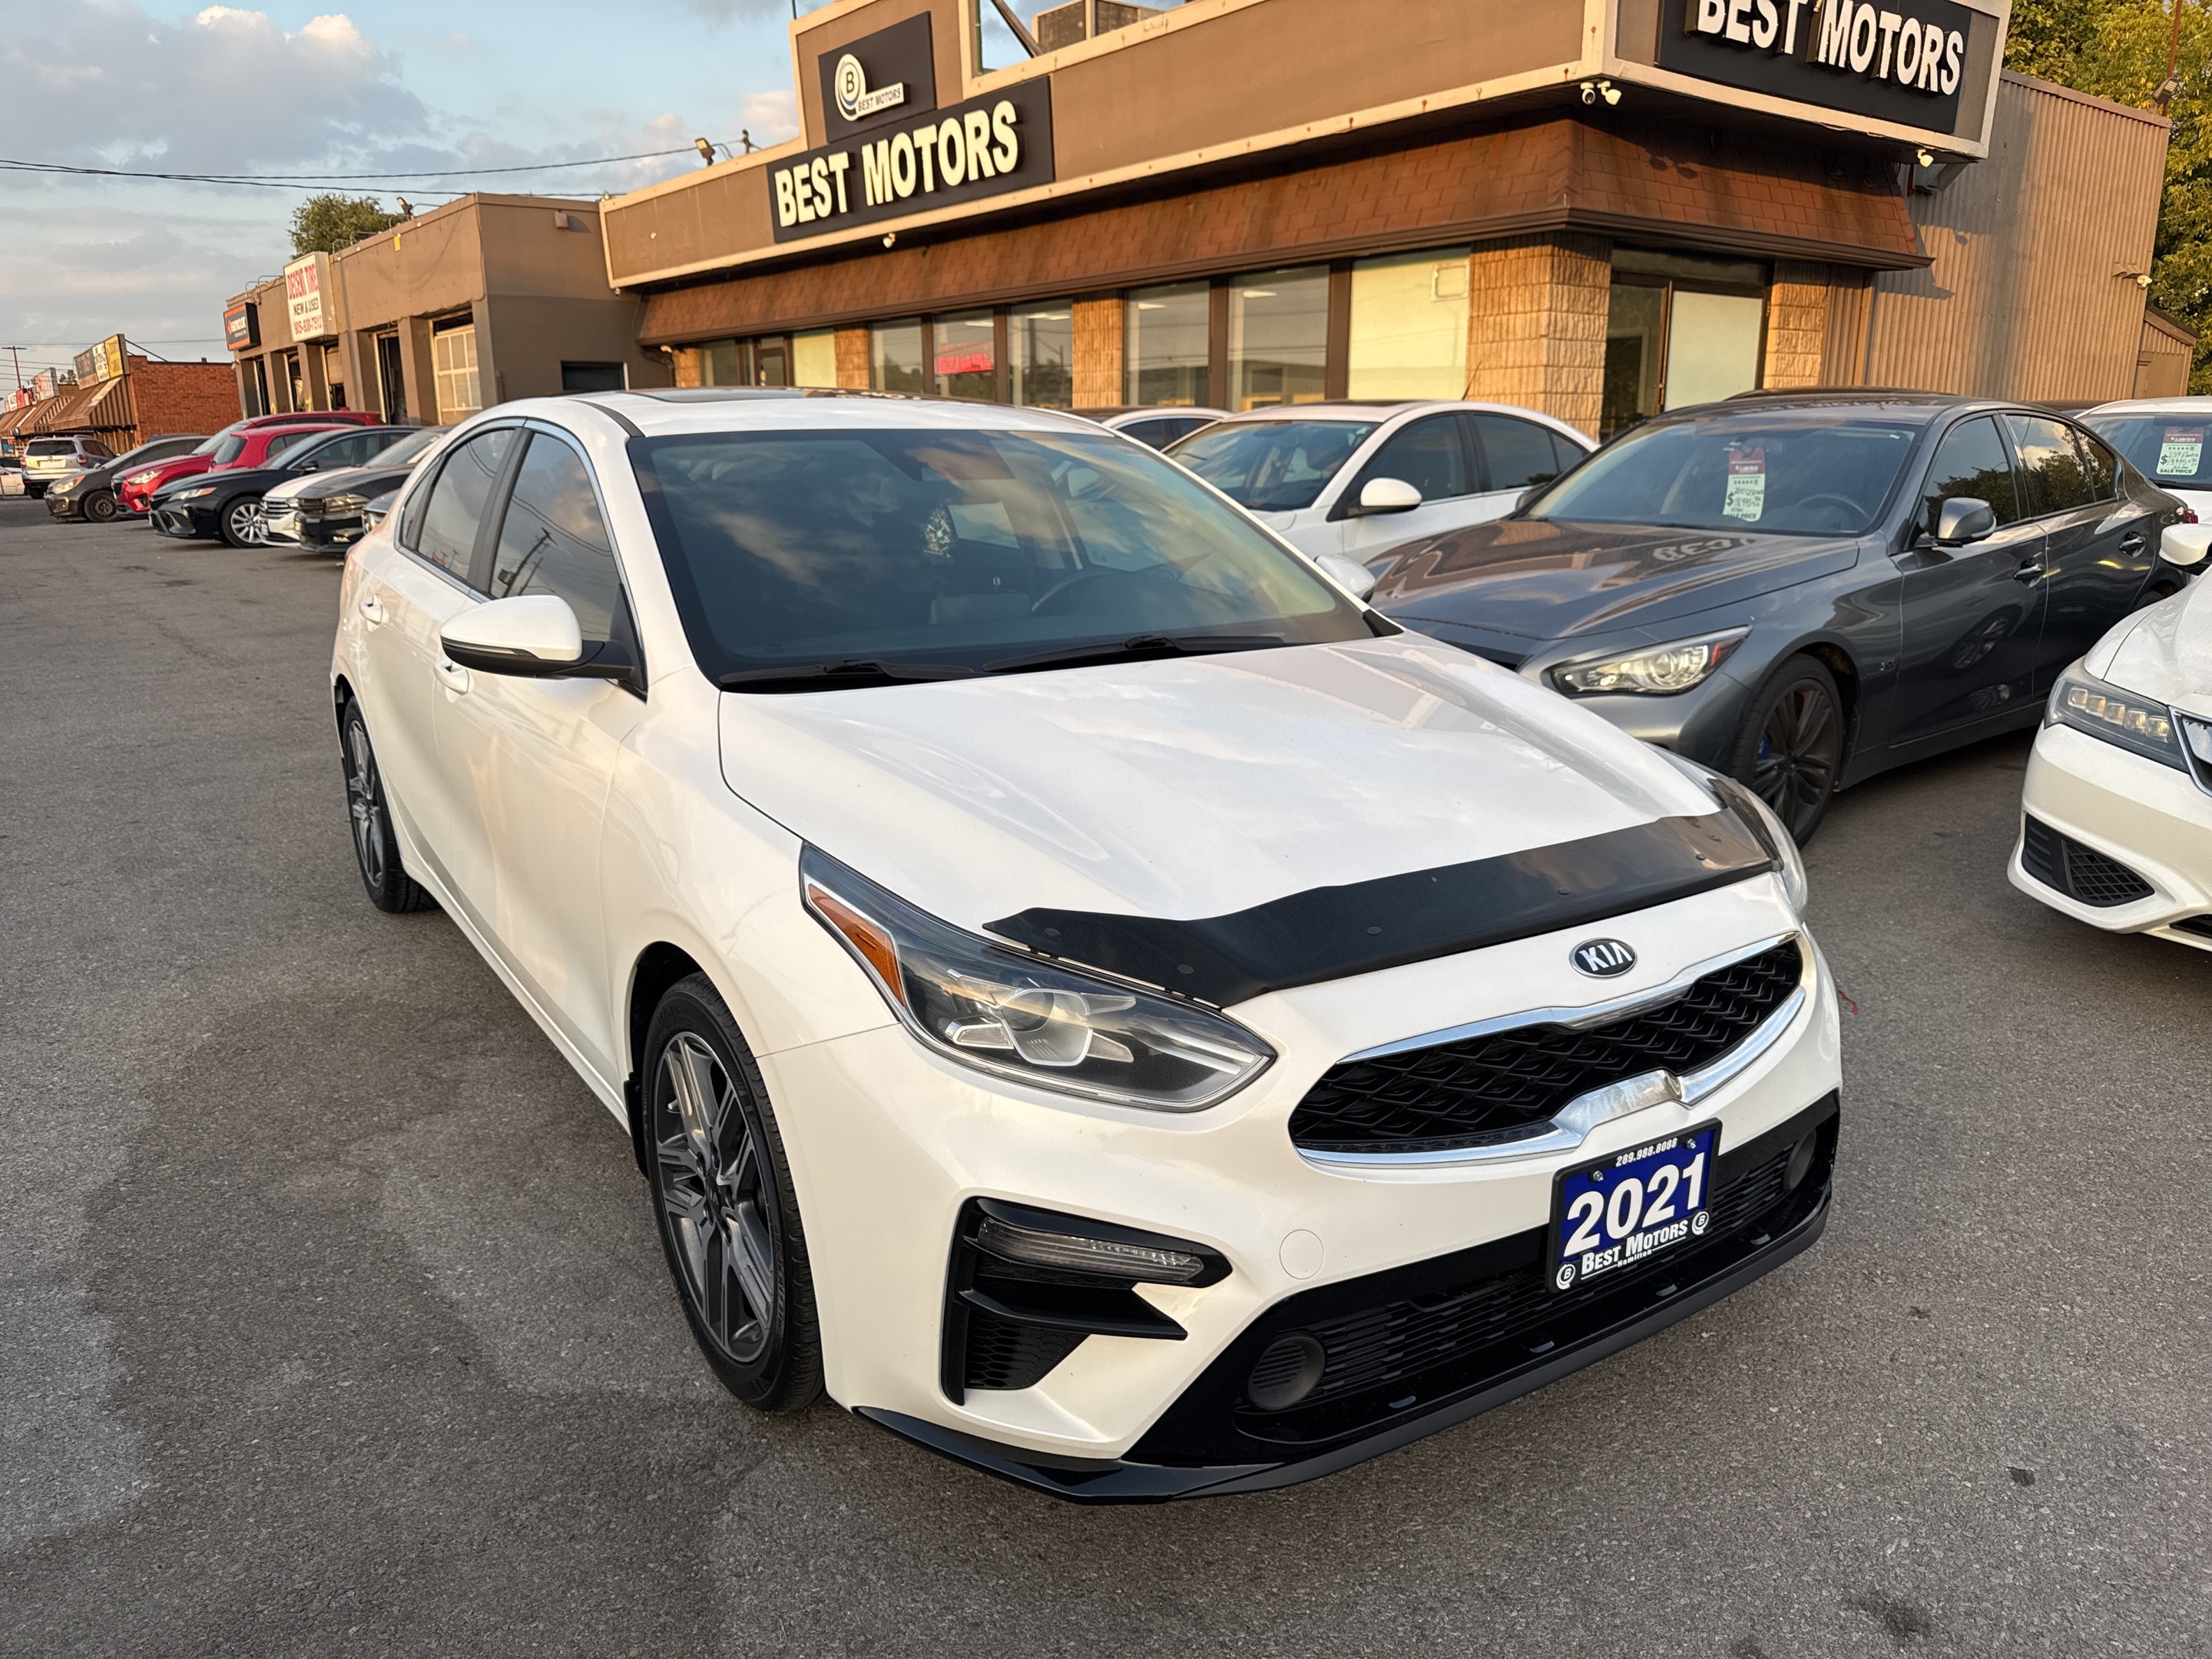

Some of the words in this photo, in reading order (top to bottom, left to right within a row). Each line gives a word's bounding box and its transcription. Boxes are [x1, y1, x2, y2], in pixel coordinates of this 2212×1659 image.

[1817, 0, 1963, 95] MOTORS
[858, 96, 874, 112] BEST
[876, 88, 901, 106] MOTORS
[774, 151, 849, 227] BEST
[861, 100, 1019, 207] MOTORS
[286, 268, 306, 300] DECENT
[293, 302, 304, 316] NEW
[308, 297, 320, 312] USED
[1578, 942, 1633, 972] KIA
[1615, 1137, 1678, 1167] 289.988.8088
[1563, 1152, 1705, 1257] 2021
[1581, 1245, 1621, 1275] BEST
[1625, 1220, 1688, 1257] MOTORS
[1617, 1250, 1652, 1267] Hamilton
